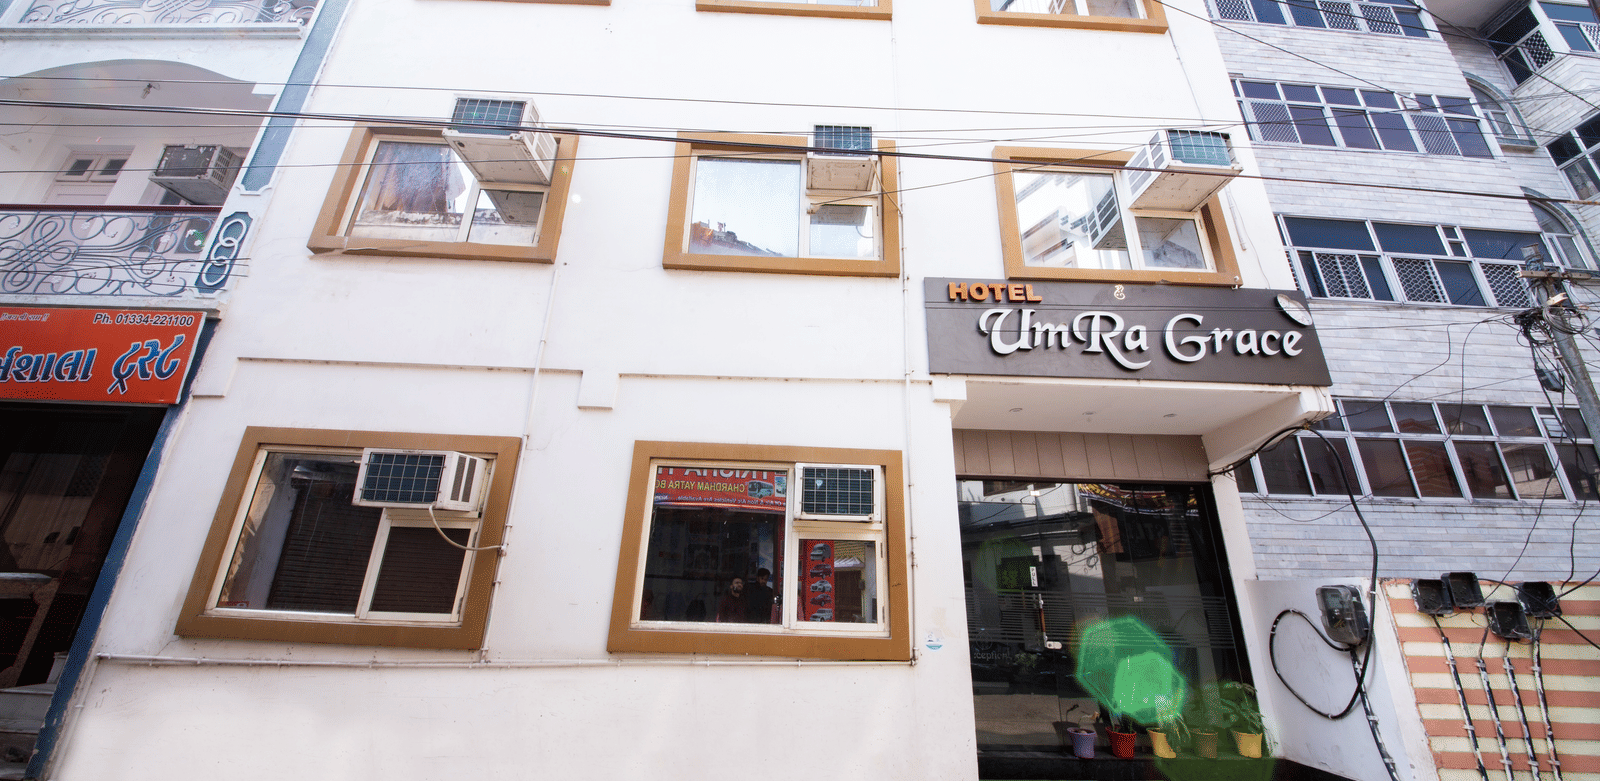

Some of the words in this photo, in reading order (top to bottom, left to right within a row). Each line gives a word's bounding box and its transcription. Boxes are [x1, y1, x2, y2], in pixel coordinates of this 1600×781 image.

[948, 282, 1042, 302] HOTEL
[93, 313, 112, 324] Ph.
[115, 313, 194, 327] 01334-221100
[979, 308, 1151, 370] UmRa
[1163, 313, 1303, 363] Grace
